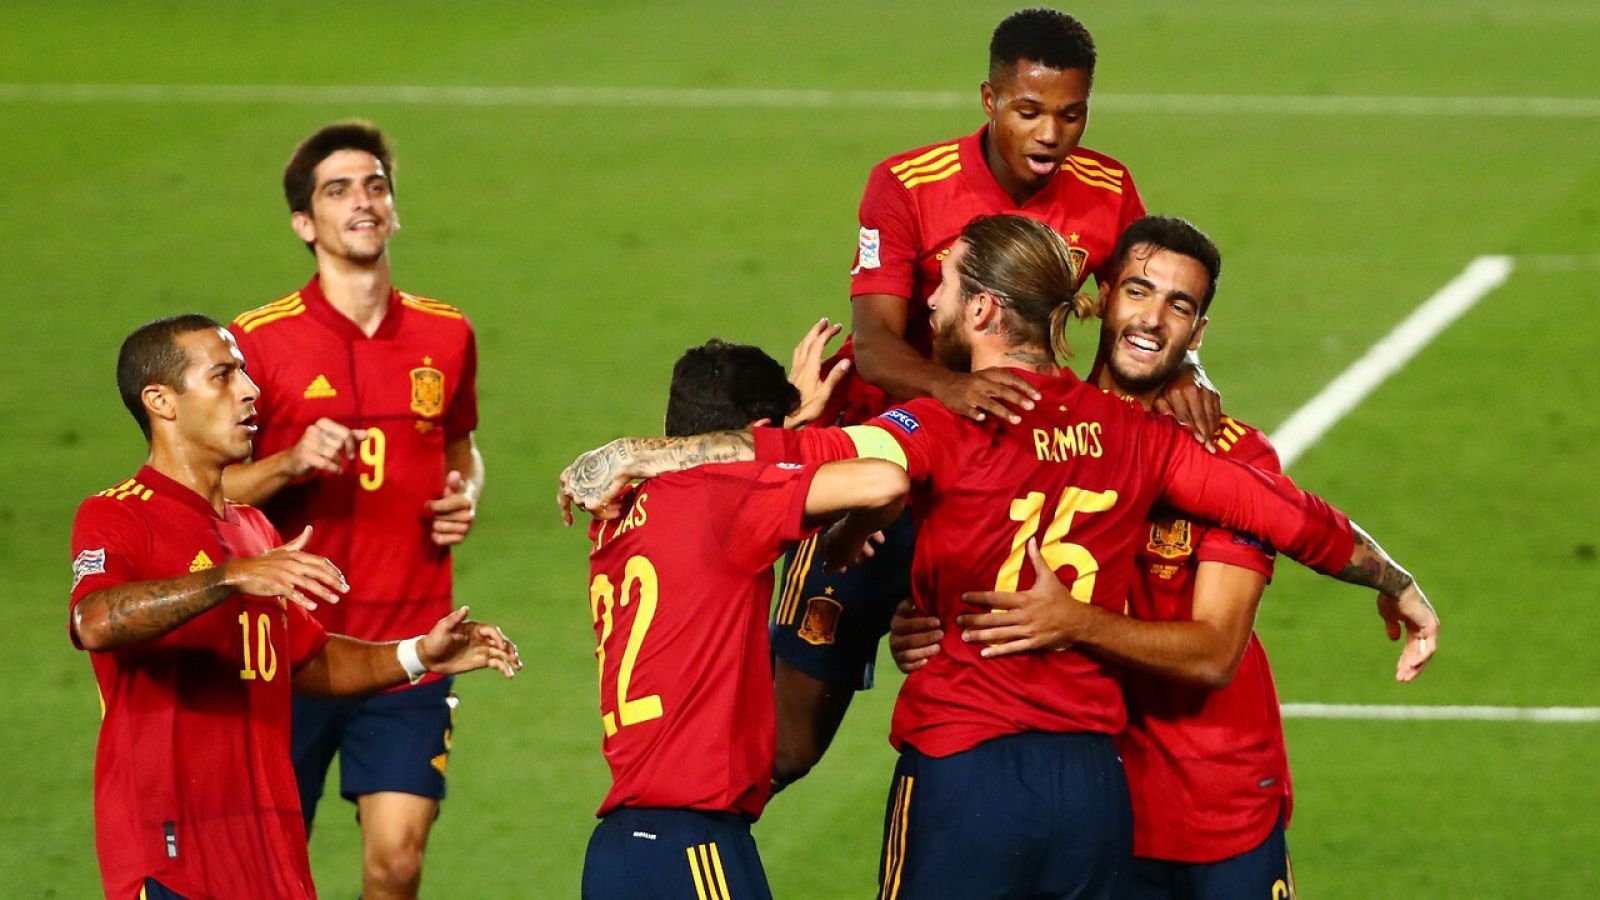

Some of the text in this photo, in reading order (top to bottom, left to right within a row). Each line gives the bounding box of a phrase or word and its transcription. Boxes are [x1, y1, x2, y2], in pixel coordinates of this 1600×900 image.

[359, 427, 386, 492] 9
[1033, 422, 1103, 463] RAMOS
[992, 486, 1118, 647] 15
[238, 611, 277, 682] 10
